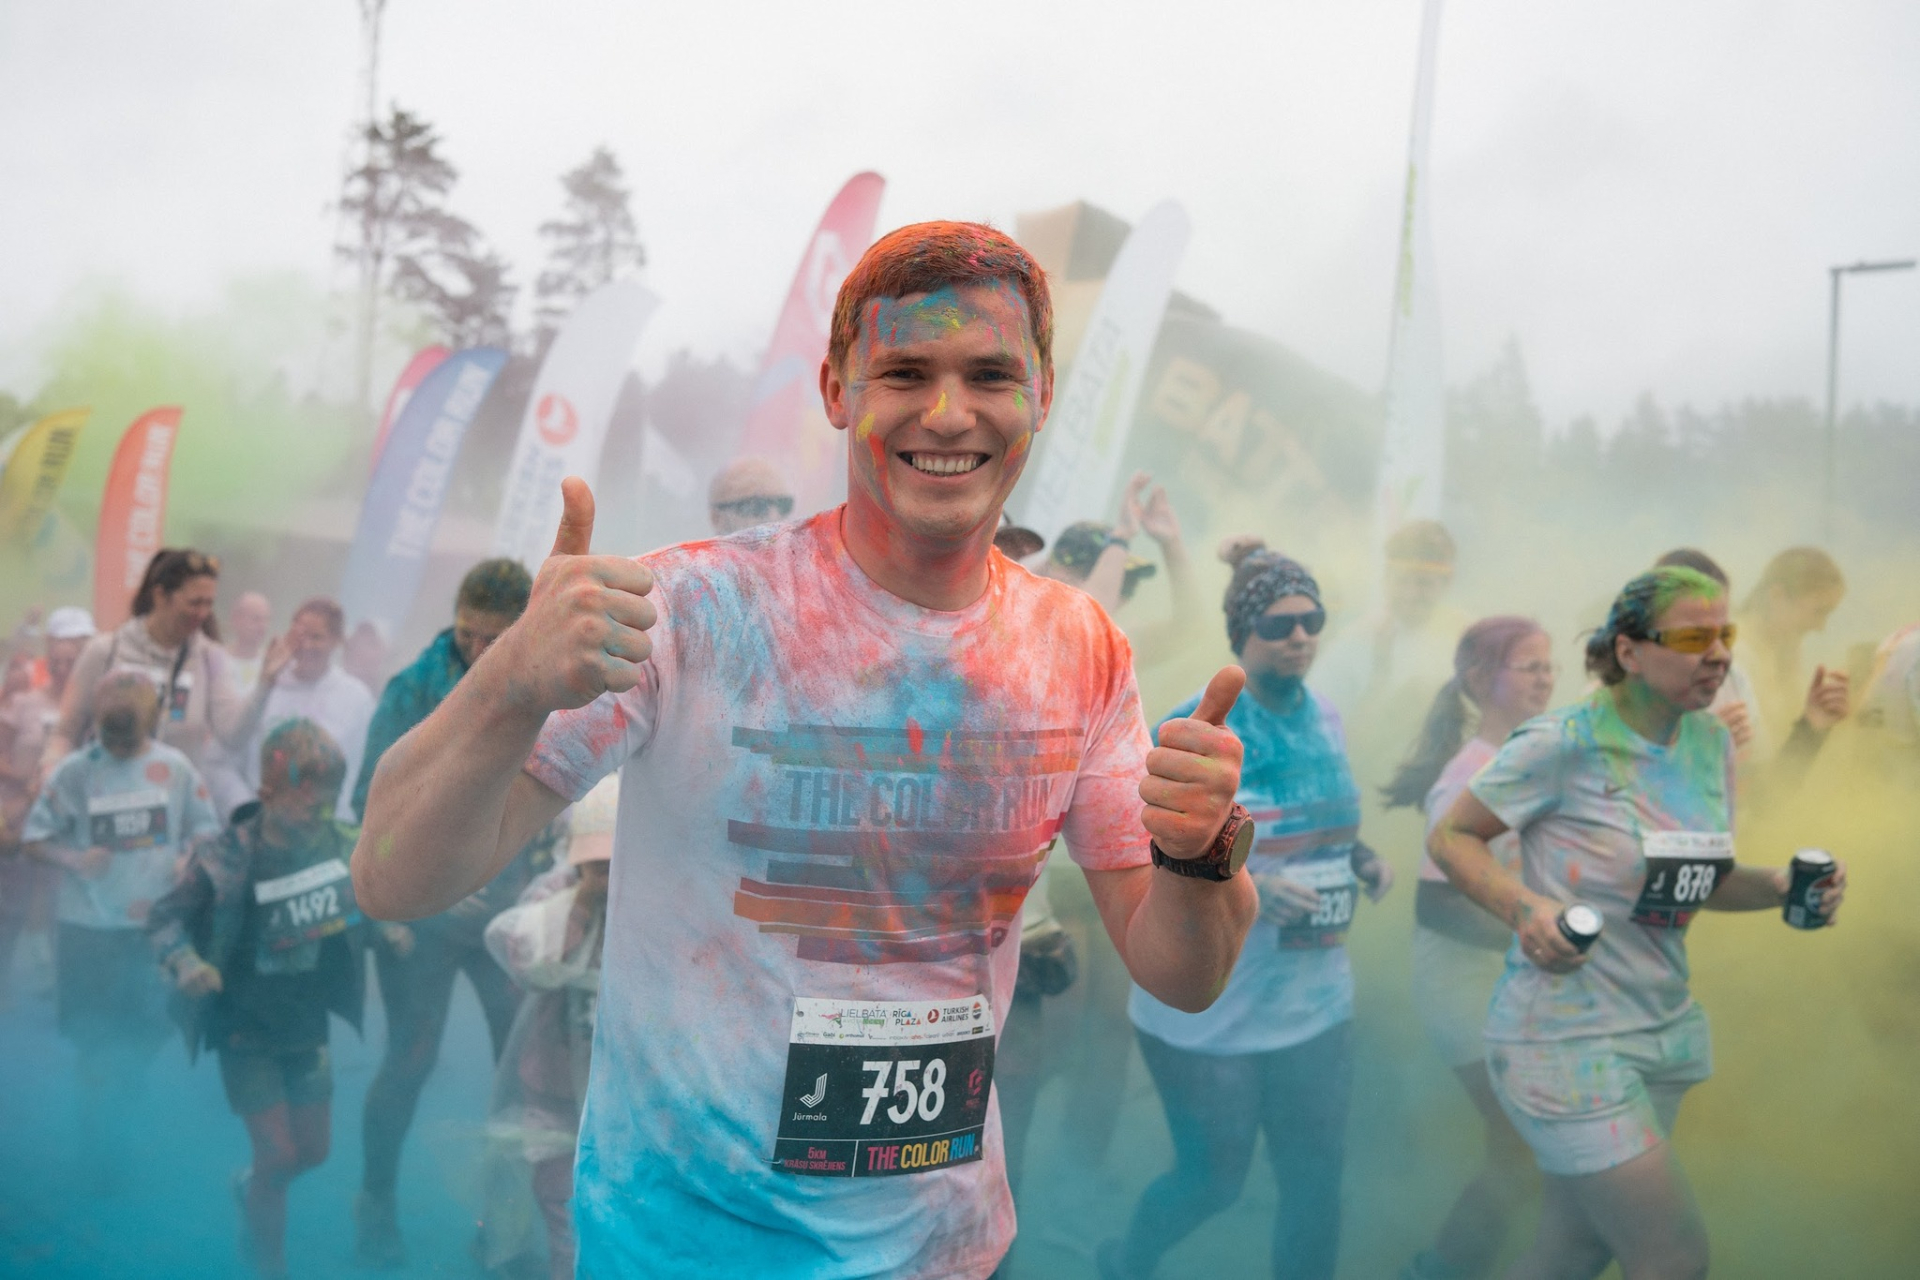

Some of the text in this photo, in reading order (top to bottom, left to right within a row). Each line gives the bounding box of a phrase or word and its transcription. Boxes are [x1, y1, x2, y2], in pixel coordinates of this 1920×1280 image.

[784, 770, 861, 827] THE
[1673, 863, 1717, 902] 878
[286, 886, 341, 926] 1492
[940, 1013, 969, 1023] AIRLINES
[943, 1005, 970, 1016] TURKISH
[859, 1058, 947, 1125] 758
[792, 1111, 828, 1121] Jūrmala
[807, 1146, 827, 1159] 5KM
[867, 1133, 976, 1171] THE COLOR RUN
